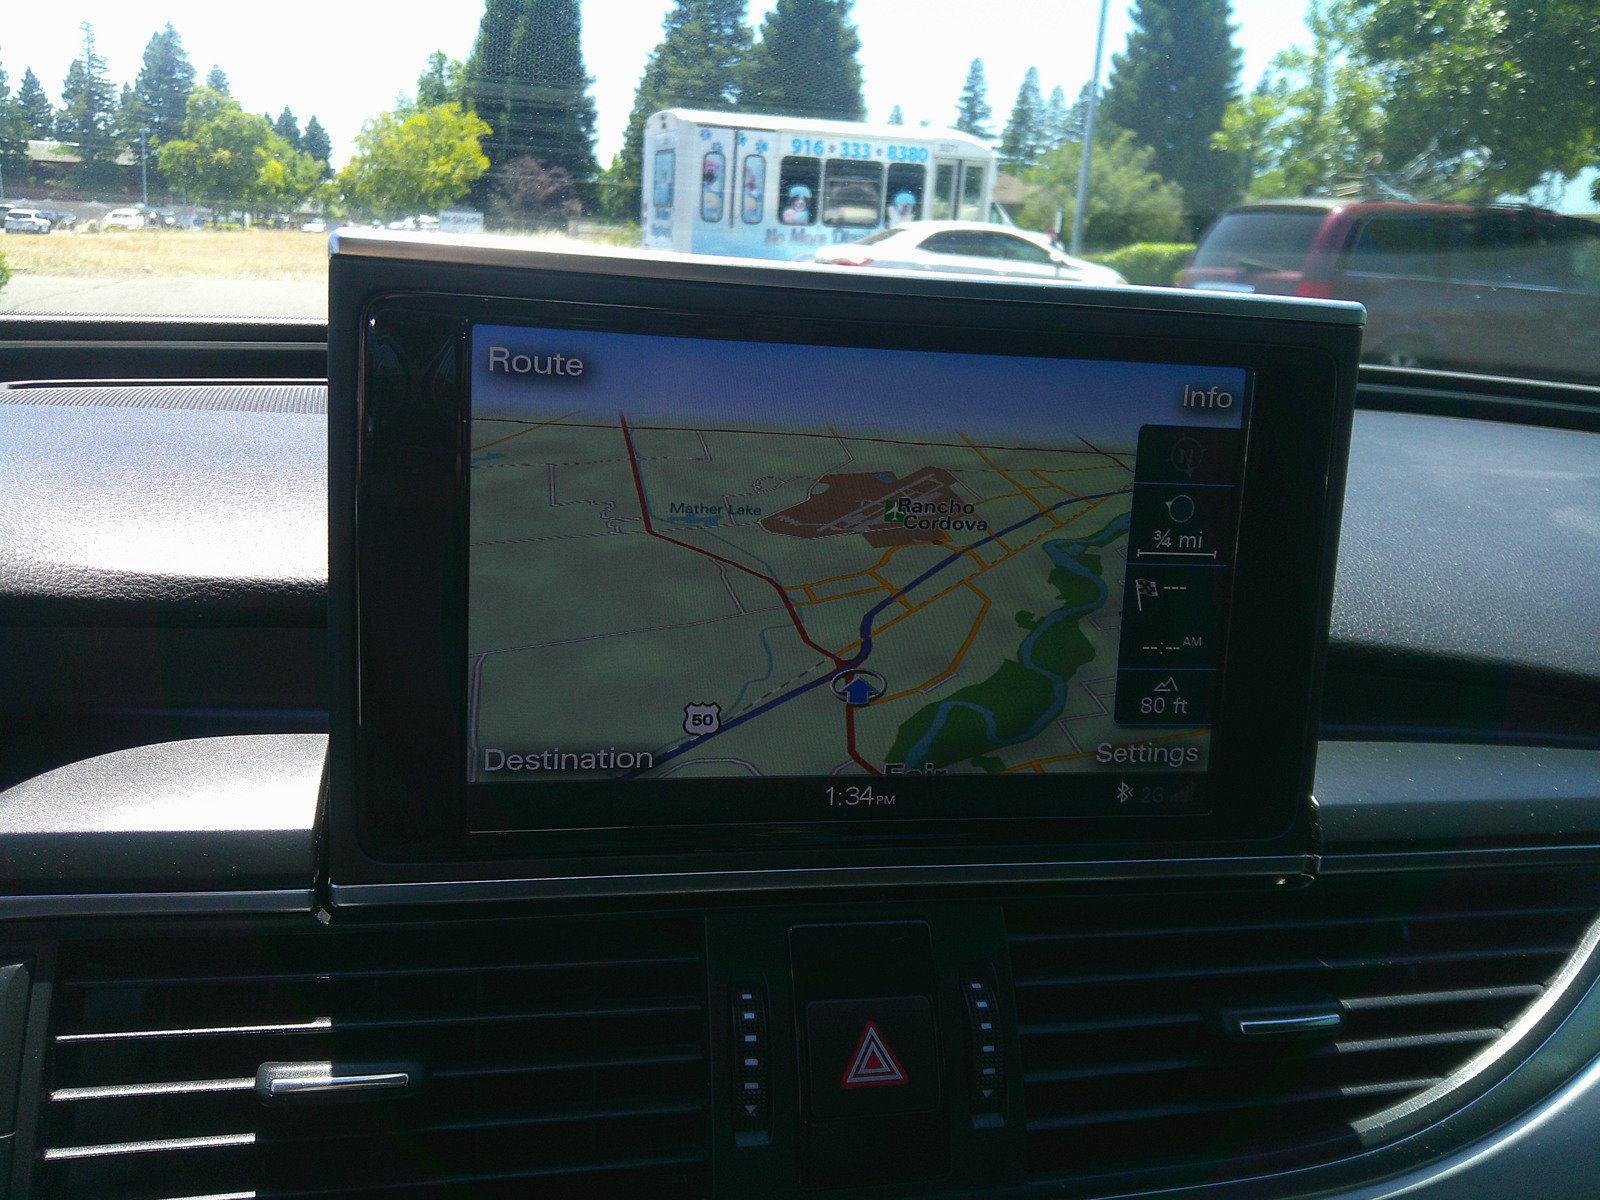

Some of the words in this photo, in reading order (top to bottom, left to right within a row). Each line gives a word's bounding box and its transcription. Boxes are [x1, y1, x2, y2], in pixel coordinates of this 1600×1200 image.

[791, 138, 824, 155] 916
[840, 141, 870, 158] 333
[887, 145, 928, 162] 8380
[488, 346, 584, 377] Route
[1182, 384, 1234, 410] Info
[670, 502, 724, 517] Mather
[728, 504, 763, 517] Lake
[898, 497, 975, 516] Rancho
[903, 514, 989, 532] Cordova
[1178, 533, 1203, 549] mi
[1183, 636, 1203, 647] AM
[1140, 696, 1166, 714] 80
[1172, 696, 1188, 714] ft
[692, 713, 714, 727] 50
[484, 747, 654, 772] Destination
[1095, 741, 1200, 767] Settings
